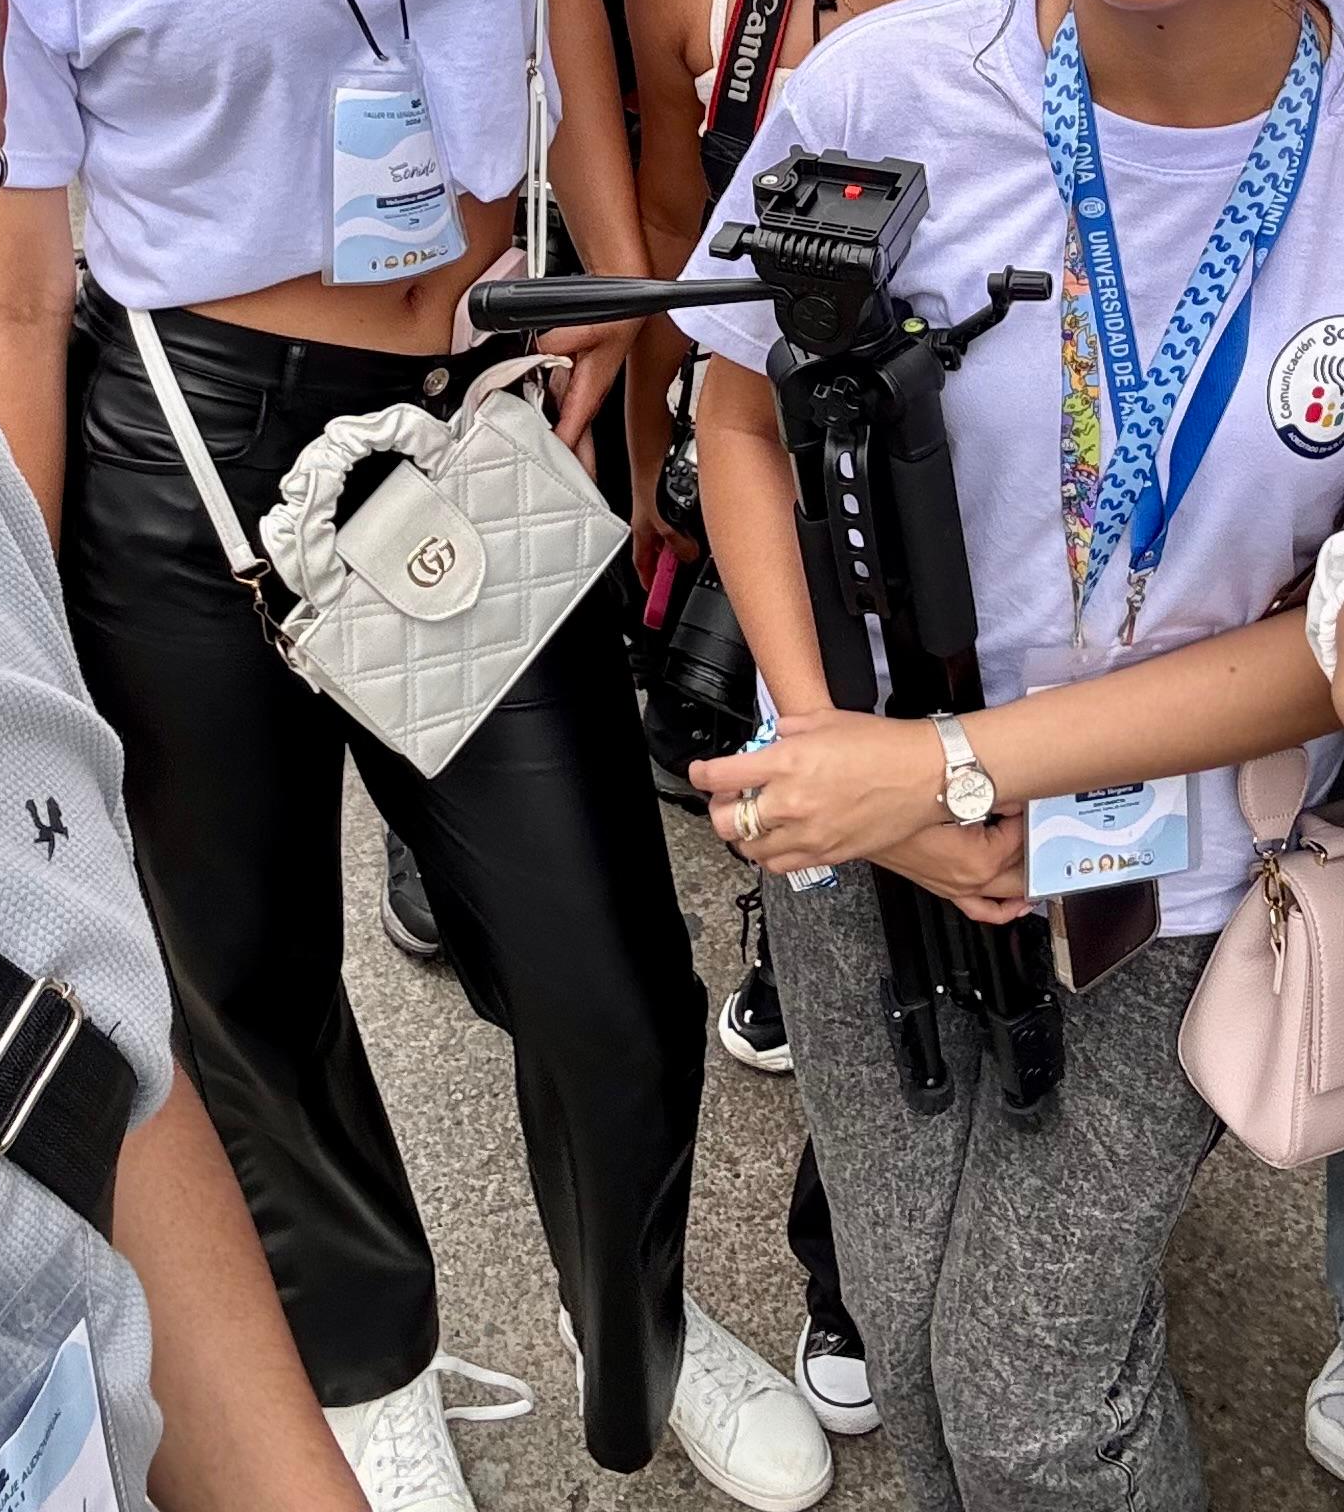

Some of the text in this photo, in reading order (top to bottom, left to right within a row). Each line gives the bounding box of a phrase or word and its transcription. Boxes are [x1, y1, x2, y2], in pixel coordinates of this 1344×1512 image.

[1087, 230, 1131, 357] UNIVERSIDAD
[1115, 356, 1136, 388] DE
[1280, 337, 1317, 420] Comunicación
